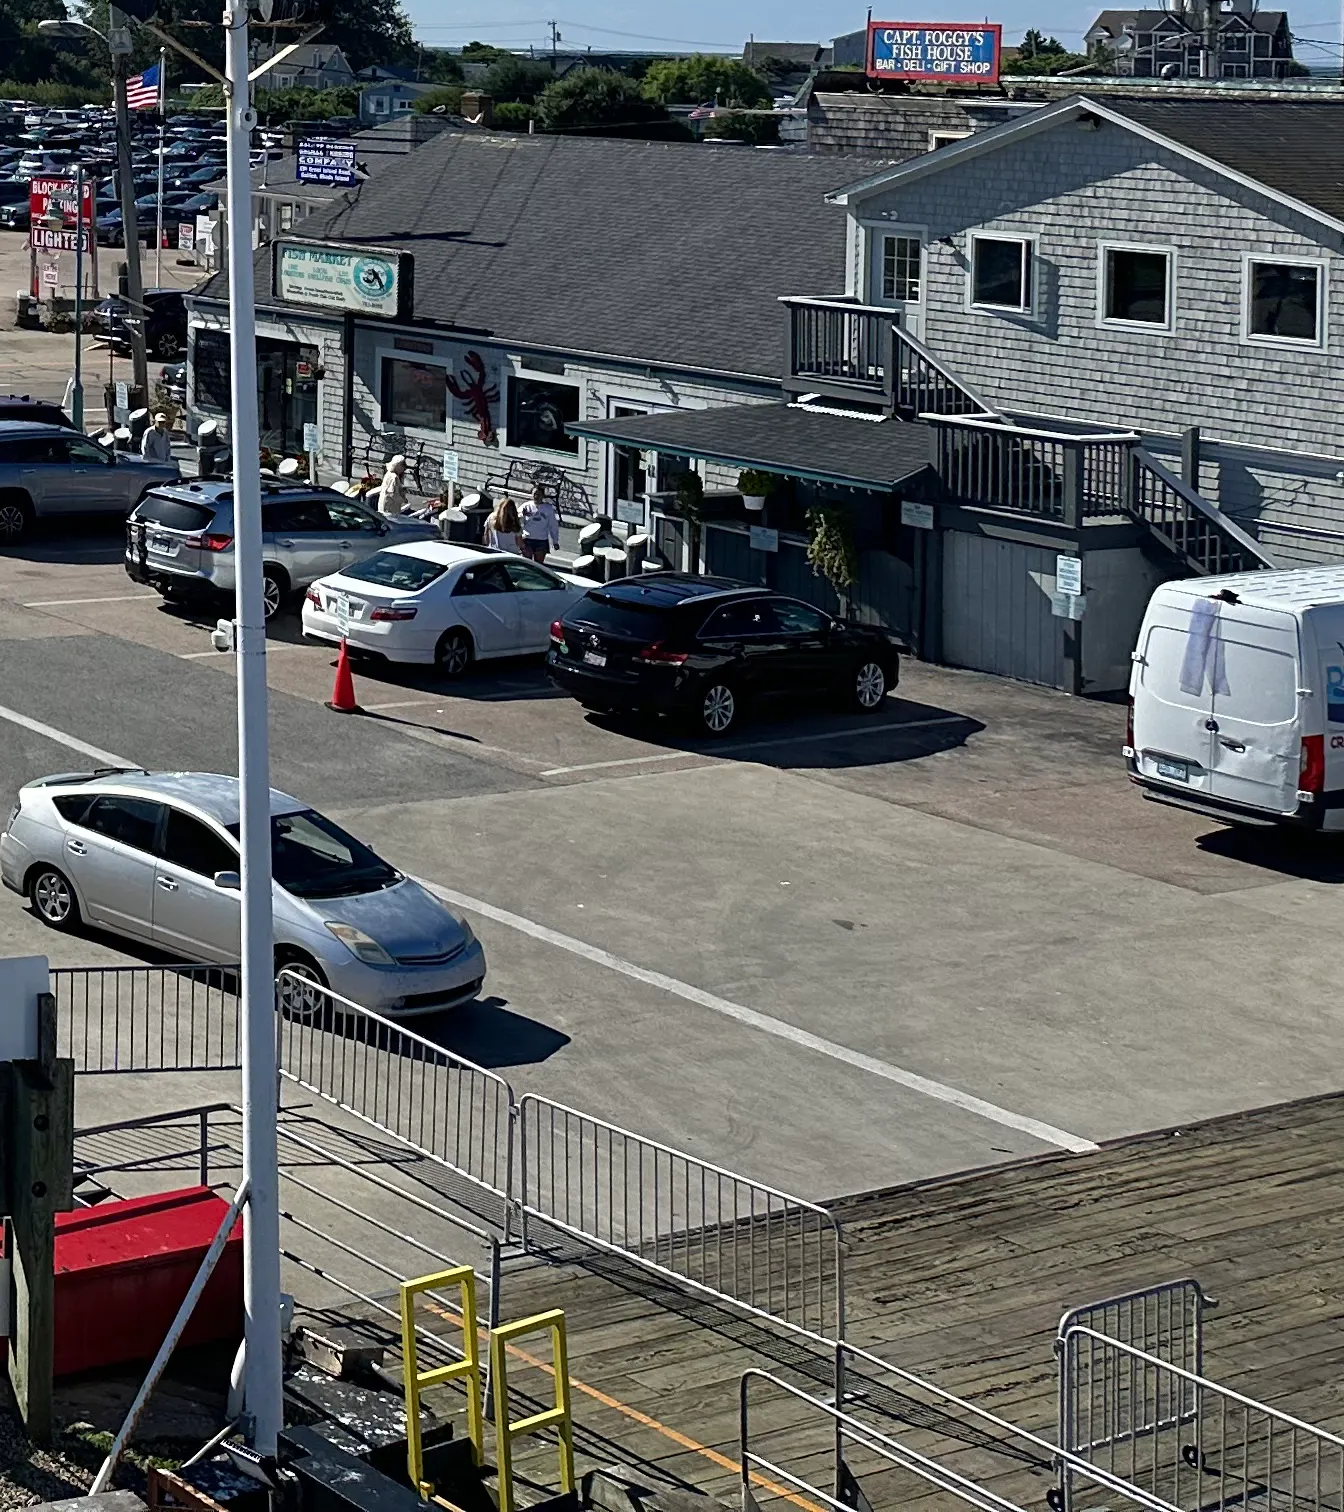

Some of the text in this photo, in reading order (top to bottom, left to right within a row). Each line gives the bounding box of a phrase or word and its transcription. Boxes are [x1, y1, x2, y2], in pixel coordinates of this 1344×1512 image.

[883, 29, 984, 46] CAPT. FOGGY'S
[892, 44, 973, 61] FISH HOUSE
[875, 58, 991, 74] BAR DELI GIFT SHOP
[298, 156, 353, 167] COMPAY
